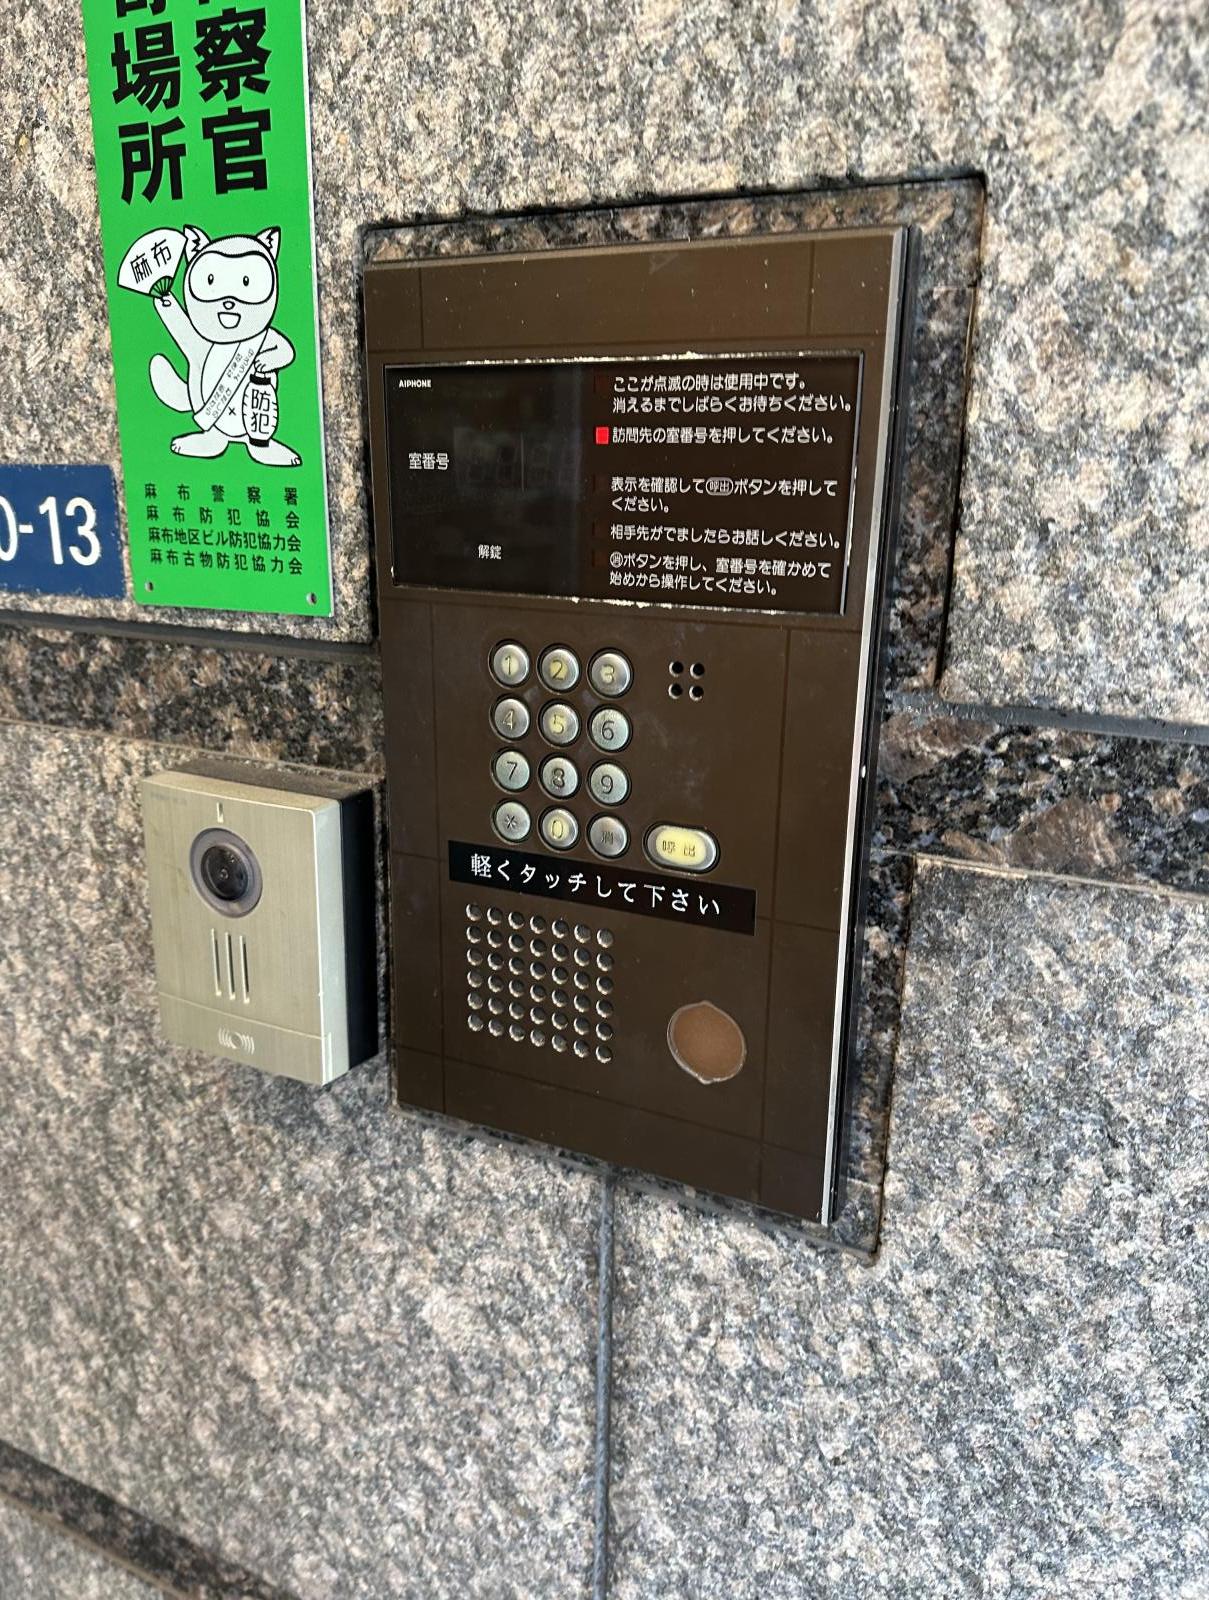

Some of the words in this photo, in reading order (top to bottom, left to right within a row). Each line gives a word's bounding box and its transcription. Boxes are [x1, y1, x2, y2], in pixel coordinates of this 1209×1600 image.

[111, 0, 187, 204] 場所
[194, 0, 272, 194] 察官
[130, 238, 172, 284] 麻布
[399, 379, 432, 388] AIPHONE
[613, 372, 806, 393] ここが点滅の時は使用中です。
[250, 388, 271, 434] 防犯
[612, 395, 852, 414] 消えるまでしばらくお待ちください。
[612, 426, 833, 444] 訪問先の室番号を押してください。
[408, 452, 449, 470] 室番号
[144, 483, 299, 506] 麻布警察署
[611, 496, 669, 513] ください。
[146, 505, 300, 529] 麻布防犯協会
[148, 527, 302, 553] 麻布地区ビル防犯協力会
[610, 524, 840, 549] 相手先がでましたらお話しください。
[150, 548, 303, 575] 麻布古物防犯協力会
[478, 544, 502, 560] 解錠
[609, 571, 777, 596] 始めから操作してください。
[551, 659, 564, 681] 2
[602, 663, 615, 684] 3
[502, 708, 514, 731] 4
[553, 714, 565, 735] 5
[602, 720, 615, 741] 6
[506, 761, 518, 780] 7
[553, 767, 565, 789] 8
[600, 774, 614, 795] 9
[551, 819, 564, 839] 0
[471, 853, 720, 915] 軽くタッチして下さい
